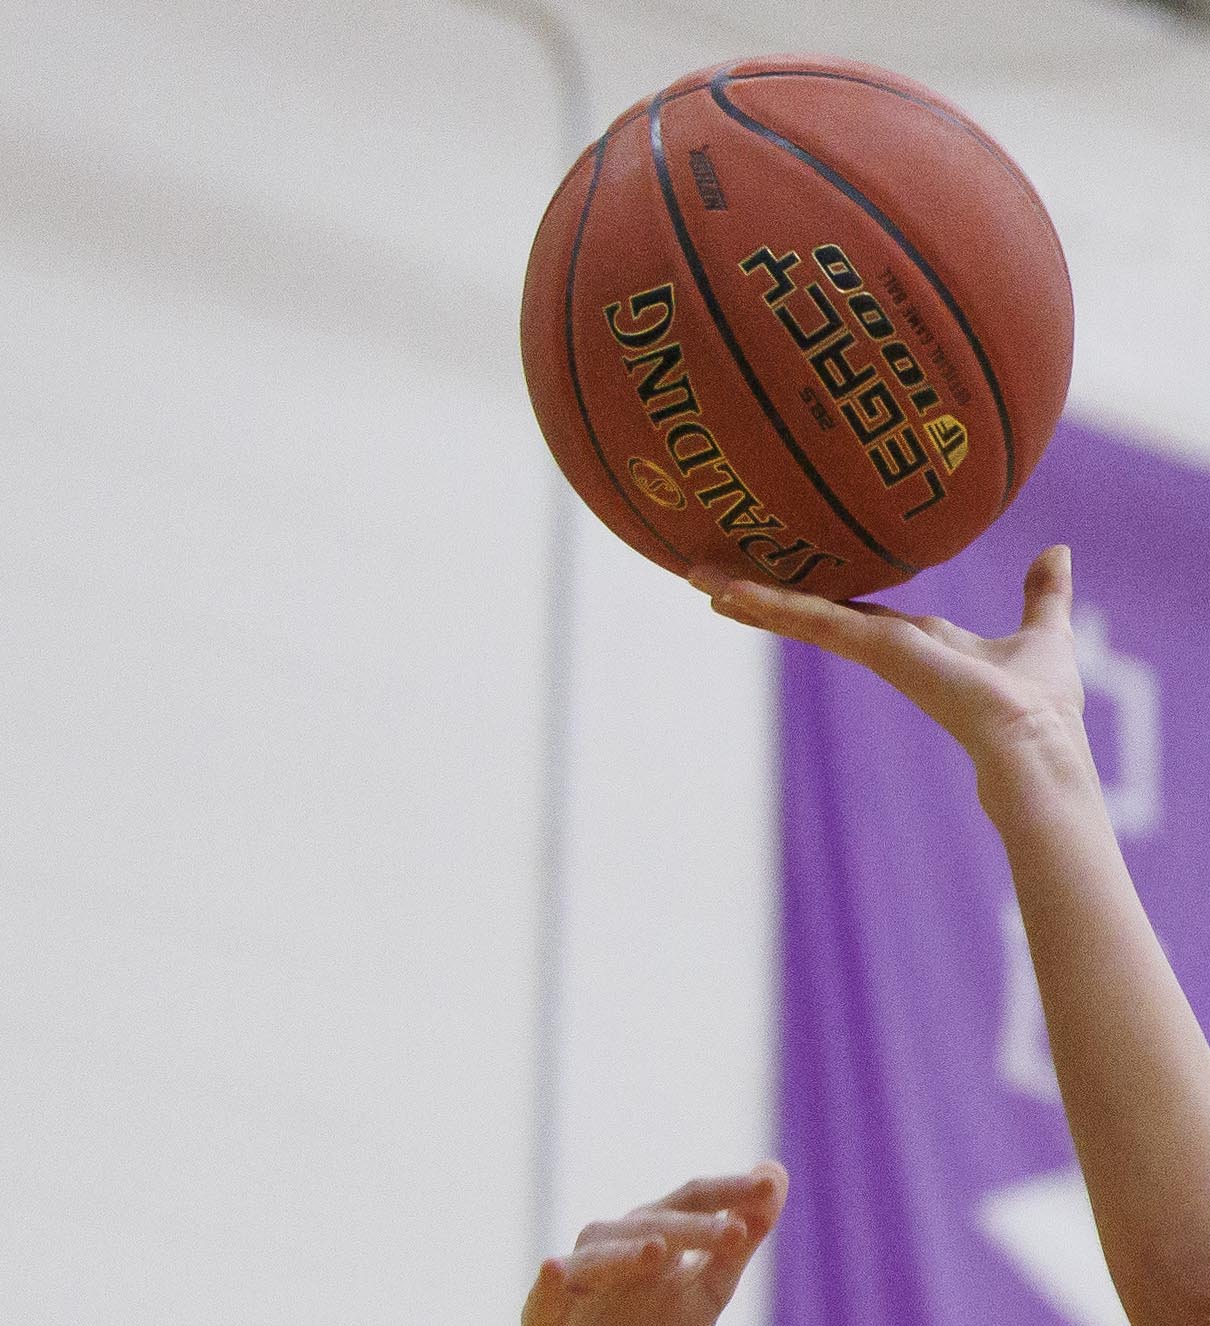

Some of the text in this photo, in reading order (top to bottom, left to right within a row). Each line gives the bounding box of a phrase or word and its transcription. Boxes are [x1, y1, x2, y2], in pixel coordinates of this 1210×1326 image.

[603, 283, 847, 585] SPALDING
[740, 246, 946, 521] LEGACY
[812, 245, 967, 474] TF 1000
